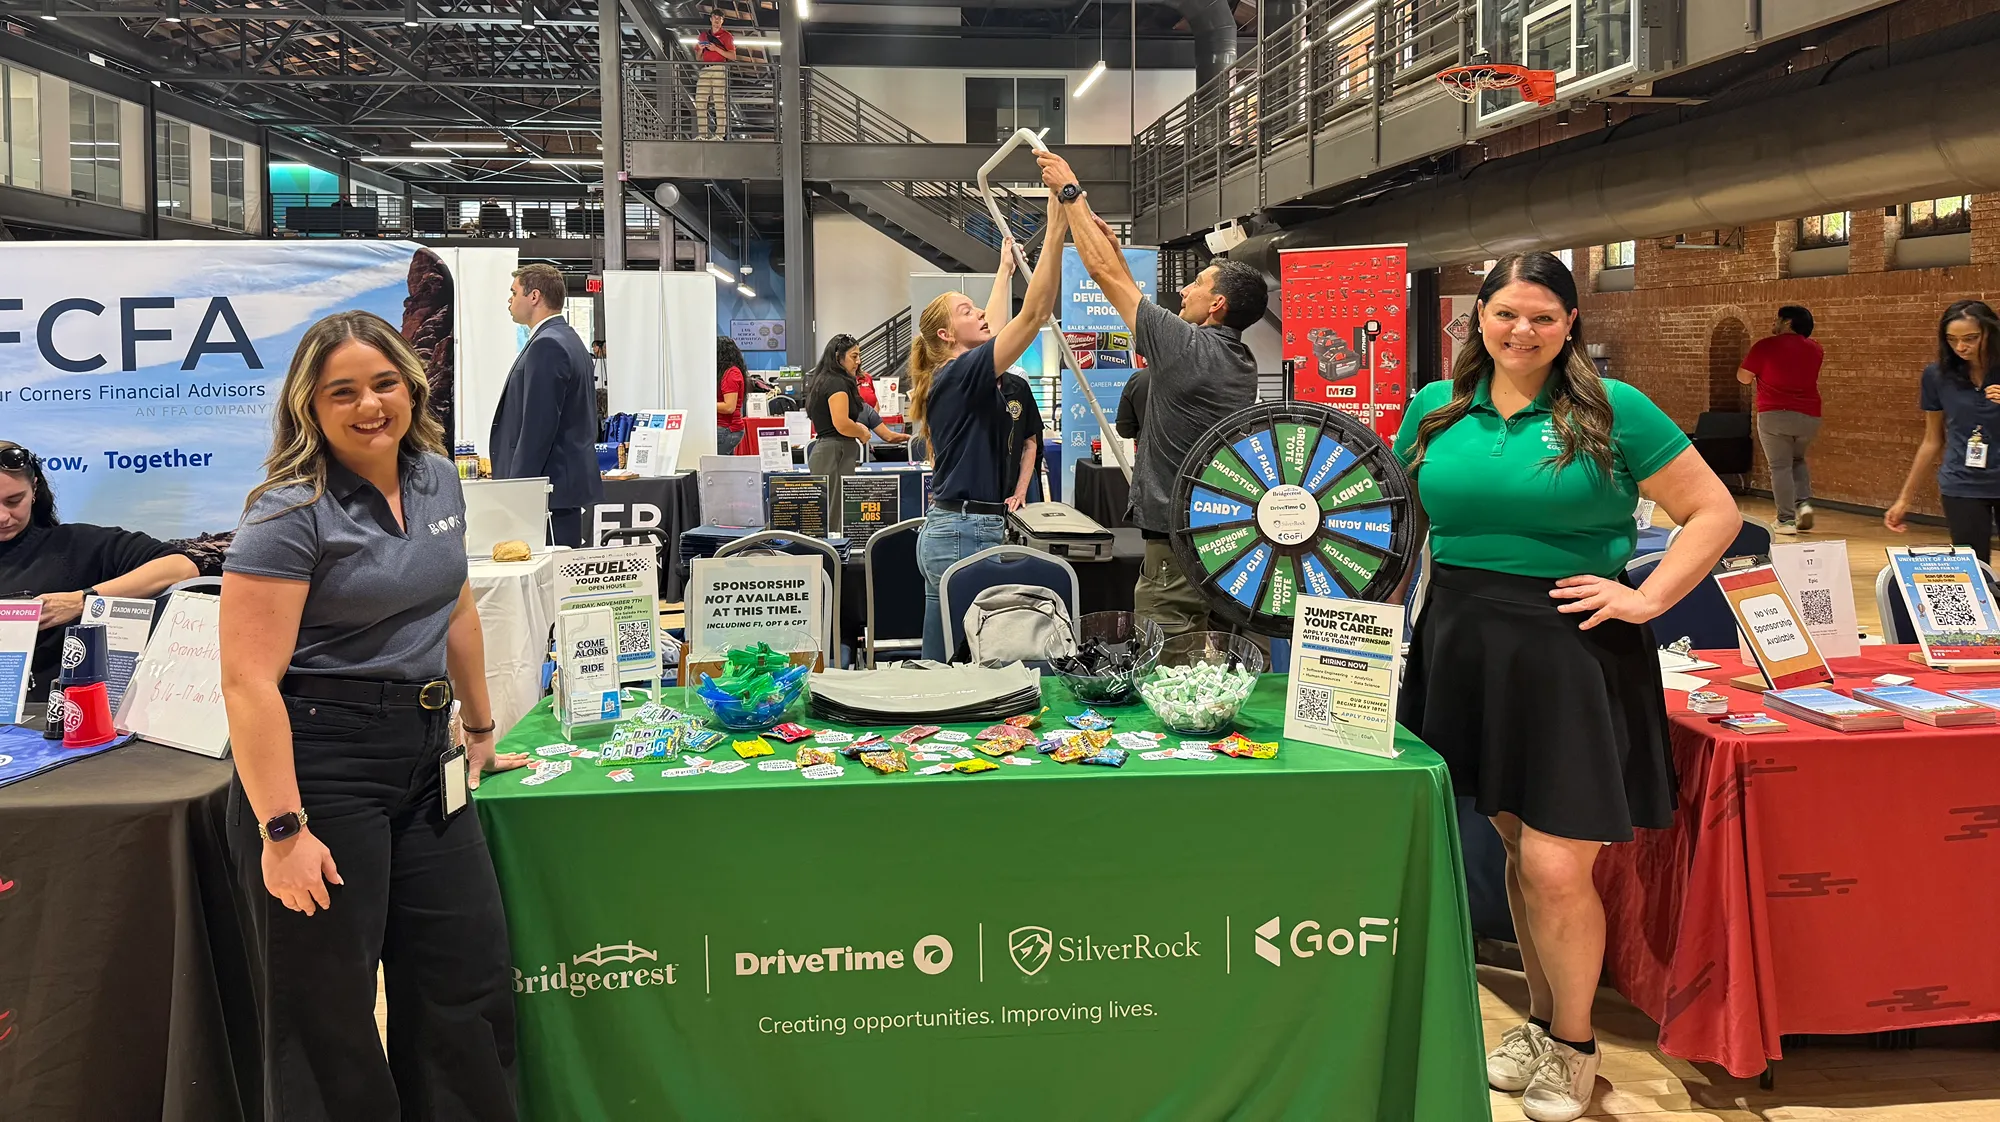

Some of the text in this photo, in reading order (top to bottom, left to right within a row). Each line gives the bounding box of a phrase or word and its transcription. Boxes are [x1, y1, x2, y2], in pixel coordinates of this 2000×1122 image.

[1100, 354, 1126, 364] ORECK
[20, 386, 92, 402] Corners
[99, 384, 180, 400] Financial
[188, 382, 266, 398] Advisors
[1328, 388, 1354, 396] M18
[135, 404, 267, 416] AN FFA COMPANY
[1285, 436, 1296, 462] TOTE
[1294, 427, 1306, 473] GROCERY
[104, 449, 212, 473] Together
[1249, 436, 1276, 482] ICE PACK
[1308, 445, 1344, 490] CHAPSTICK
[1212, 460, 1259, 496] CHAPSTICK
[1332, 478, 1373, 506] CANDY
[861, 502, 880, 512] FBI
[1194, 501, 1241, 516] CANDY
[861, 512, 880, 521] JOBS
[1328, 519, 1390, 532] SPIN AGAIN
[1198, 528, 1249, 554] HEADPHONE
[1214, 541, 1238, 556] CASE
[584, 560, 628, 575] FUEL
[1322, 544, 1372, 580] CHAPSTICK
[575, 574, 638, 585] YOUR CAREER
[1229, 549, 1265, 595] CHIP CLIP
[713, 580, 805, 591] SPONSORSHIP
[1272, 567, 1283, 613] GROCERY
[1316, 572, 1331, 594] CASE
[705, 592, 809, 604] NOT AVAILABLE
[1282, 578, 1292, 604] TOTE
[712, 605, 801, 617] AT THIS TIME.
[1304, 607, 1377, 625] JUMPSTART
[1754, 607, 1778, 618] No Visa
[1304, 616, 1393, 637] YOUR CAREER!
[1754, 618, 1792, 634] Sponsorship
[577, 639, 605, 650] COME
[1331, 637, 1356, 646] TODAY!
[1350, 636, 1390, 646] INTERNSHIP
[1766, 633, 1795, 645] Available
[573, 647, 608, 659] ALONG
[581, 663, 604, 674] RIDE
[1322, 658, 1347, 667] HIRING
[1363, 699, 1387, 707] SUMMER
[735, 945, 904, 976] DriveTime
[1058, 932, 1200, 963] SilverRock
[1289, 916, 1399, 958] GoFi
[758, 1001, 1158, 1035] Creating opportunities. Improving lives.
